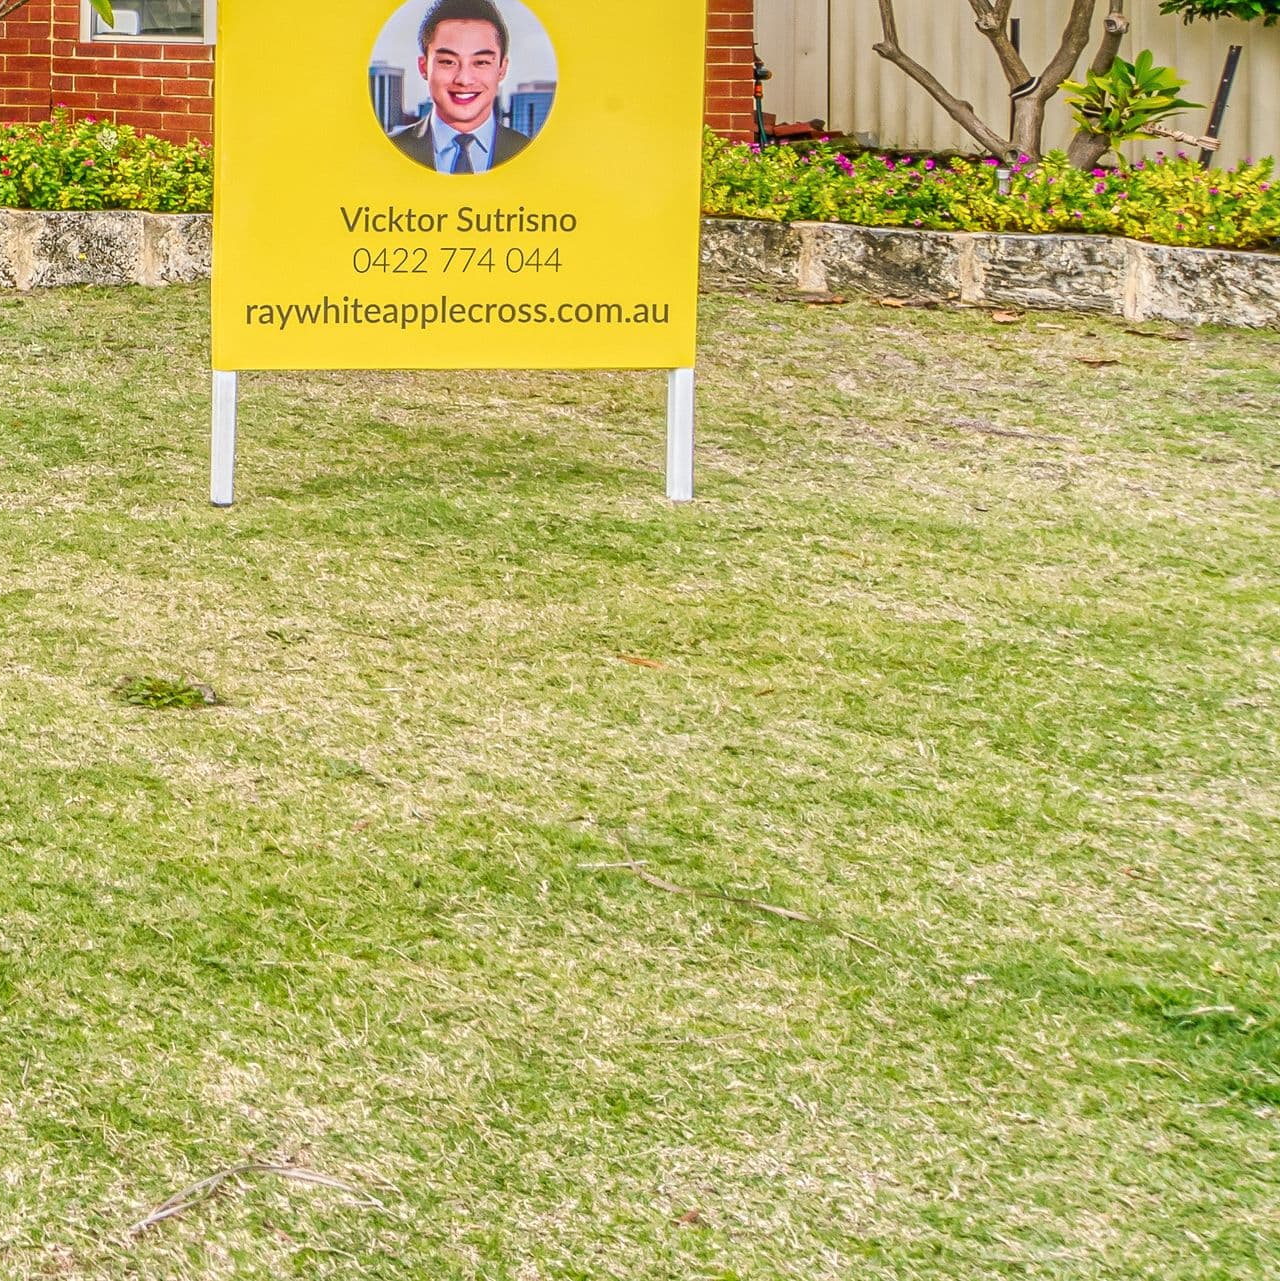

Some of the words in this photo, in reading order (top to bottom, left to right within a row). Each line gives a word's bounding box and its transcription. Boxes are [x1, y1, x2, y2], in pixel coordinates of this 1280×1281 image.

[340, 206, 448, 233] Vicktor
[456, 206, 578, 233] Sutrisno
[352, 247, 428, 274] 0422
[439, 247, 496, 273] 774
[505, 247, 563, 274] 044
[245, 295, 670, 331] raywhiteapplecross.com.au
